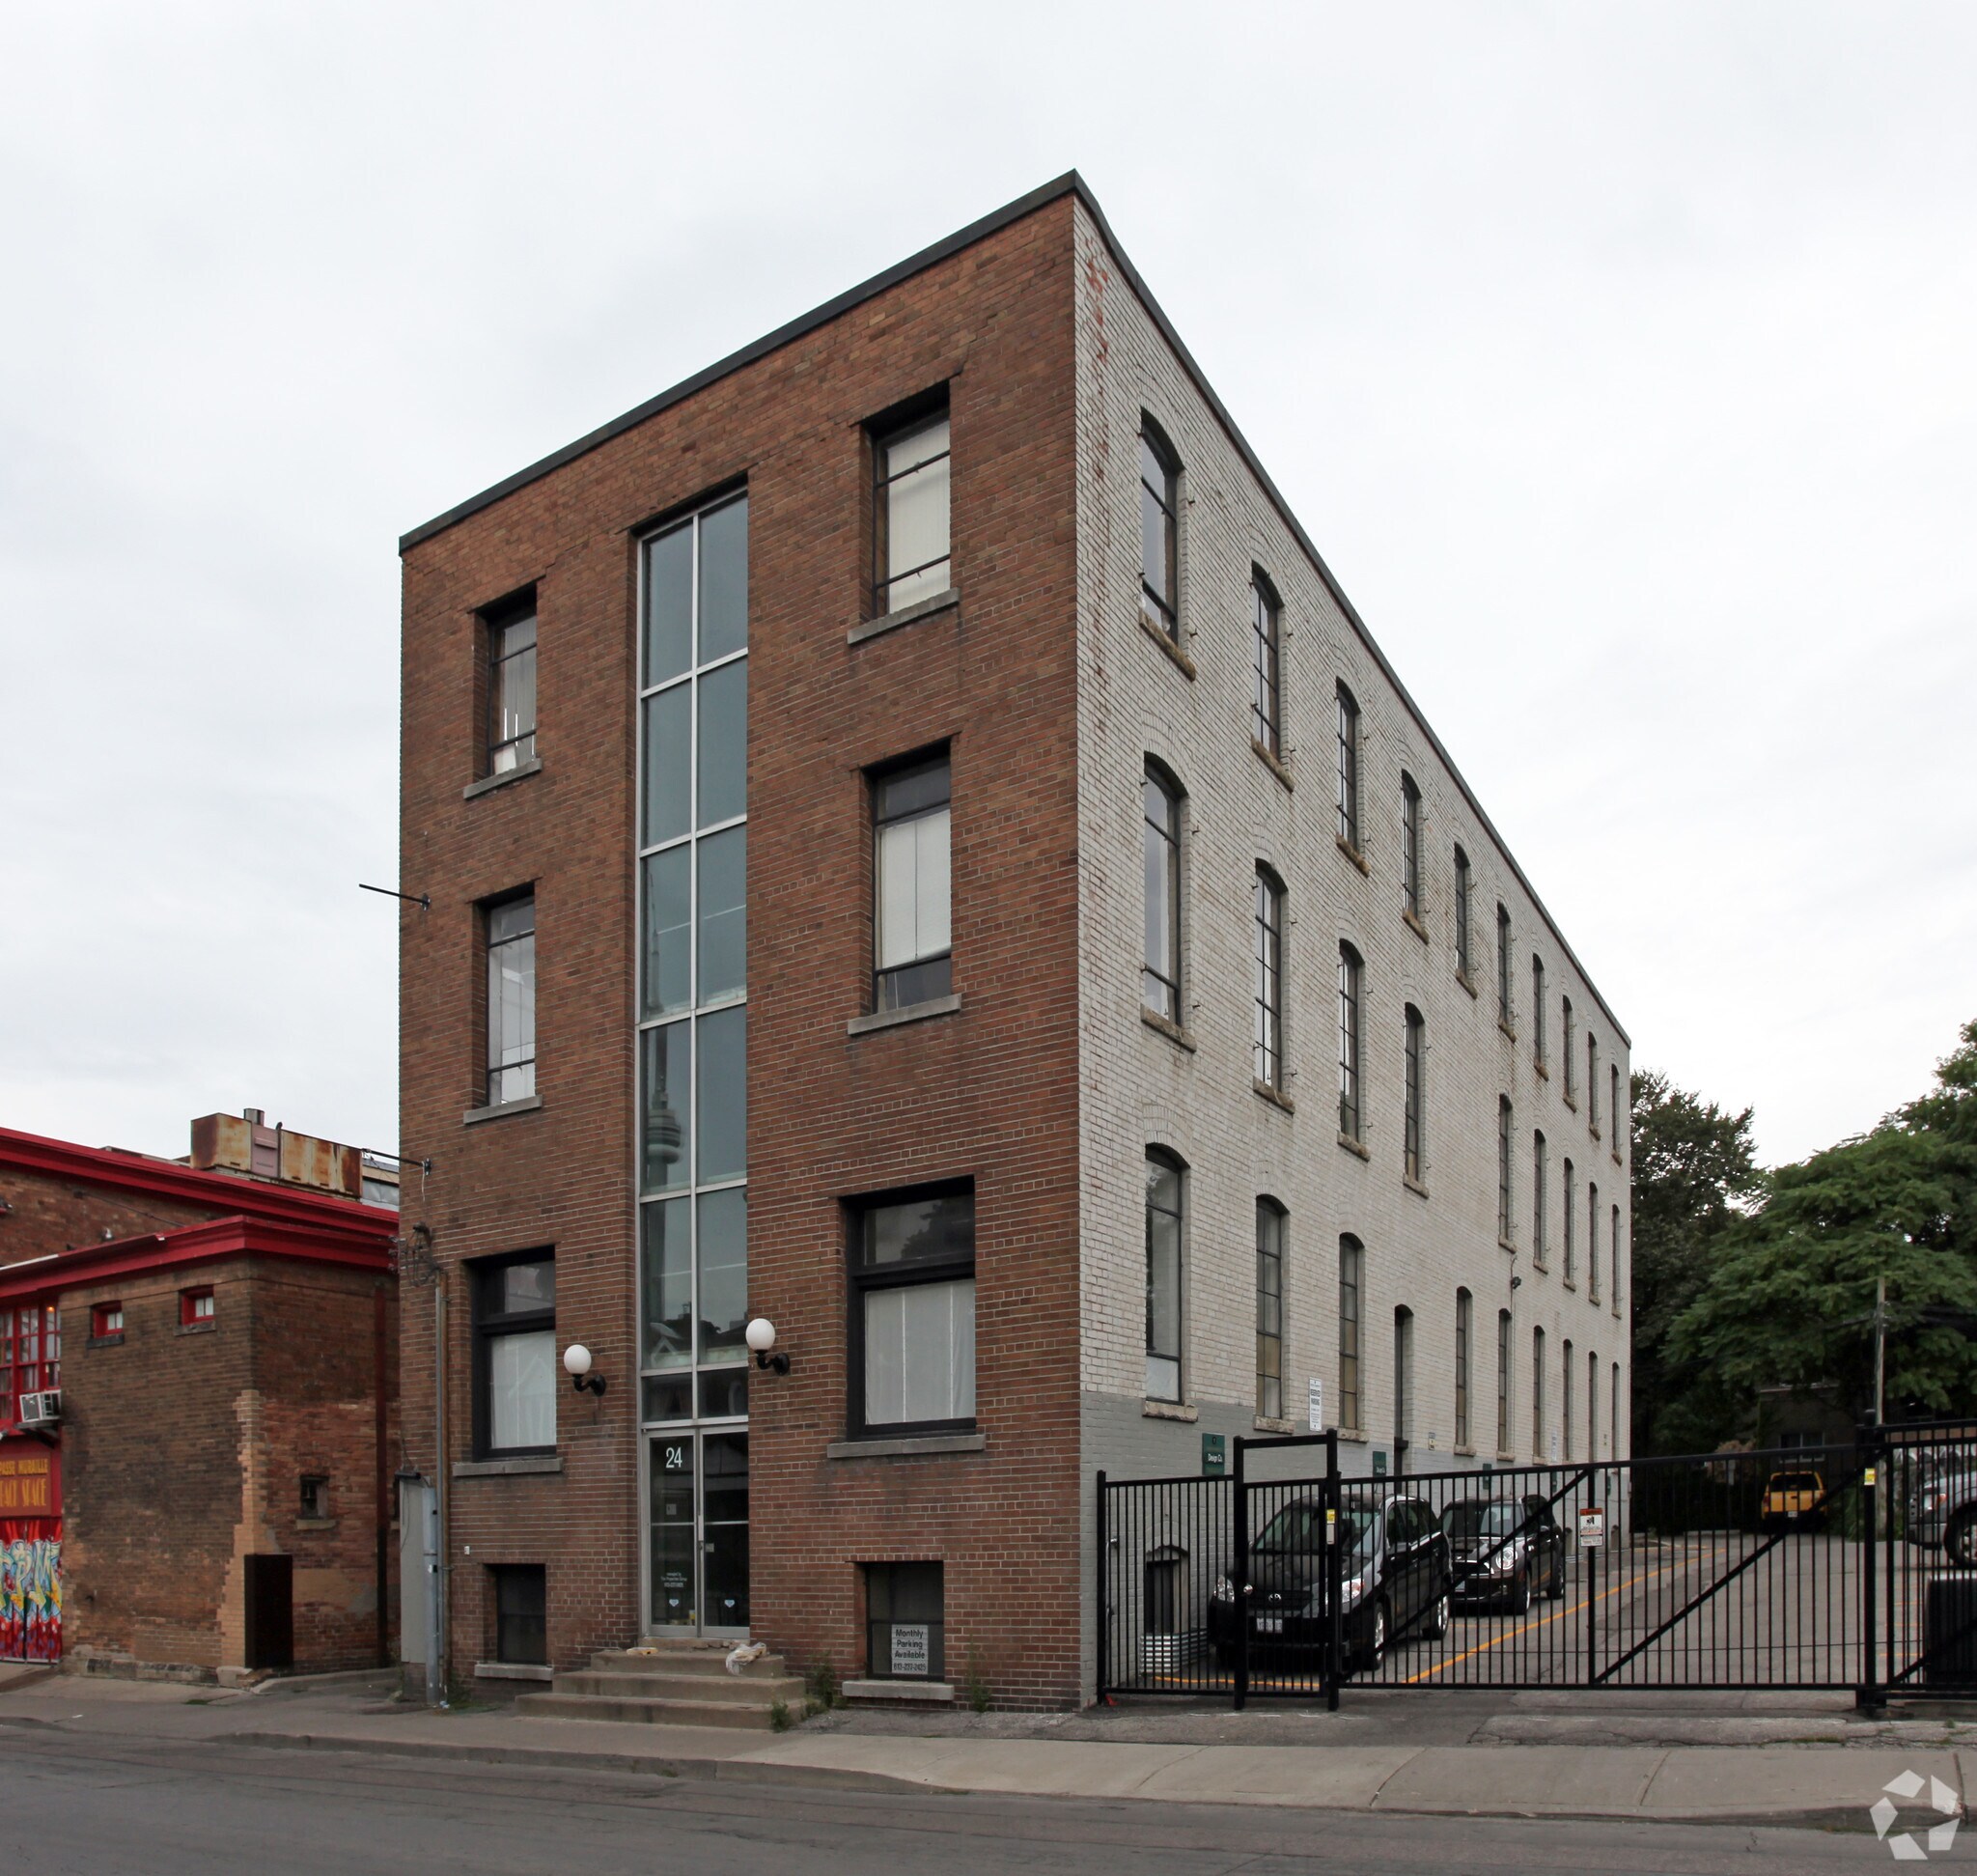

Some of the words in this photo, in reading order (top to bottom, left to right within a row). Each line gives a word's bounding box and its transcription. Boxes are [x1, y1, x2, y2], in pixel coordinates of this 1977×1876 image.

[665, 1447, 682, 1469] 24
[896, 1629, 924, 1638] Monthly
[897, 1639, 923, 1650] Parking
[895, 1650, 925, 1659] Available
